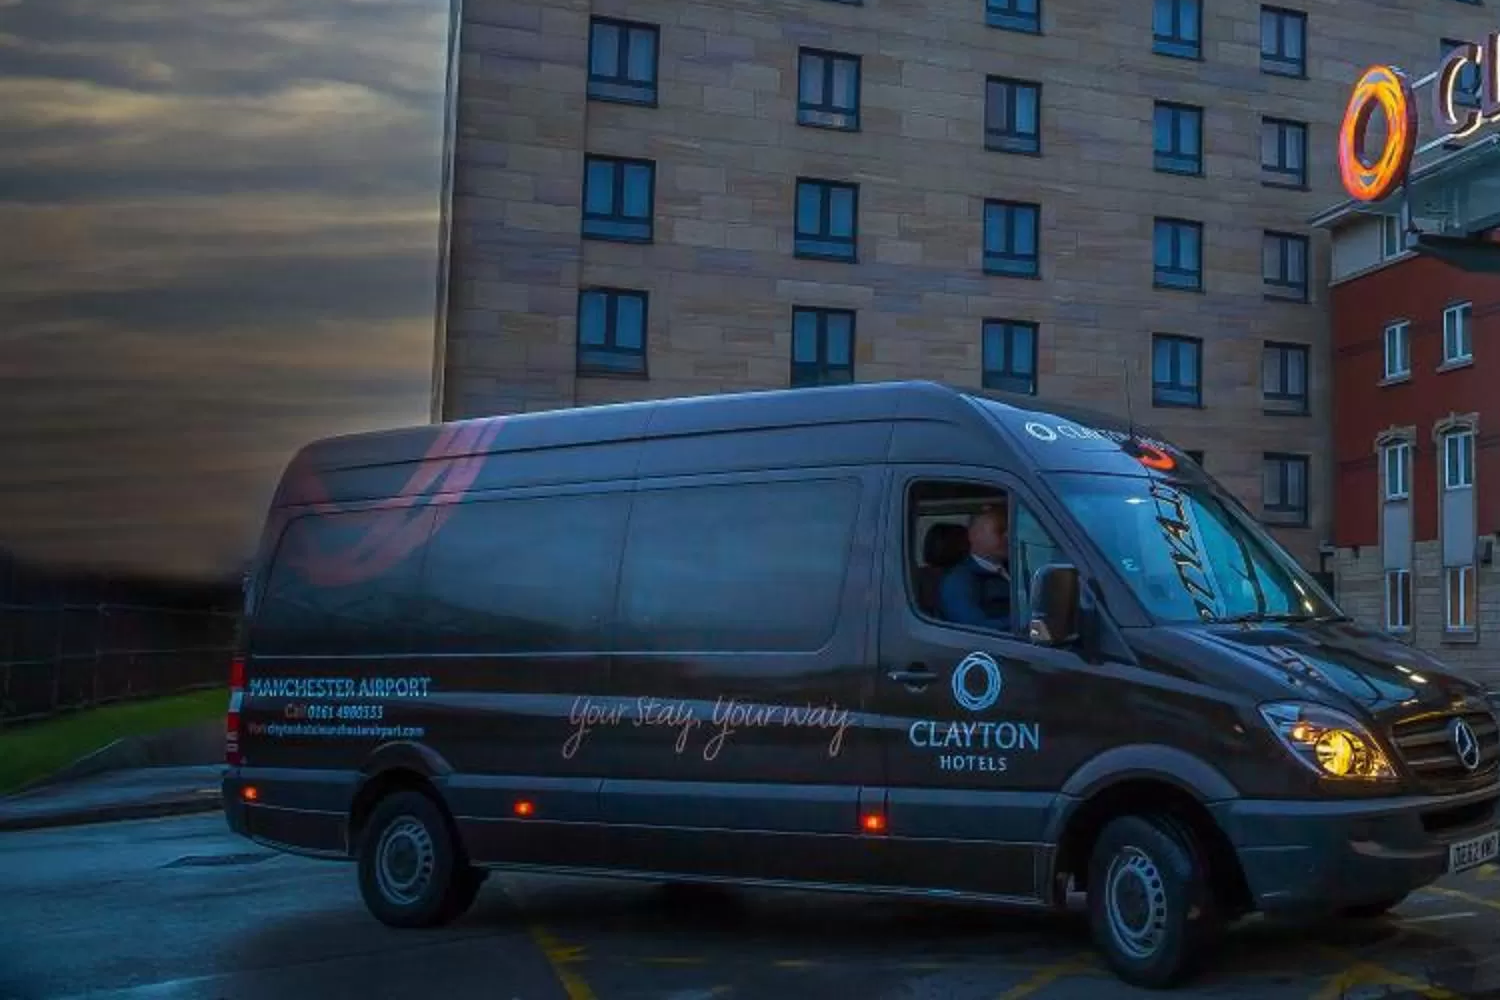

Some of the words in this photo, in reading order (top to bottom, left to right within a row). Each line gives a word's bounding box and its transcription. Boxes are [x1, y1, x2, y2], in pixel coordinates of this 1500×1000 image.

[249, 678, 355, 697] MANCHESTER
[358, 677, 431, 697] AIRPORT
[909, 720, 1040, 750] CLAYTON
[939, 755, 1008, 772] HOTELS
